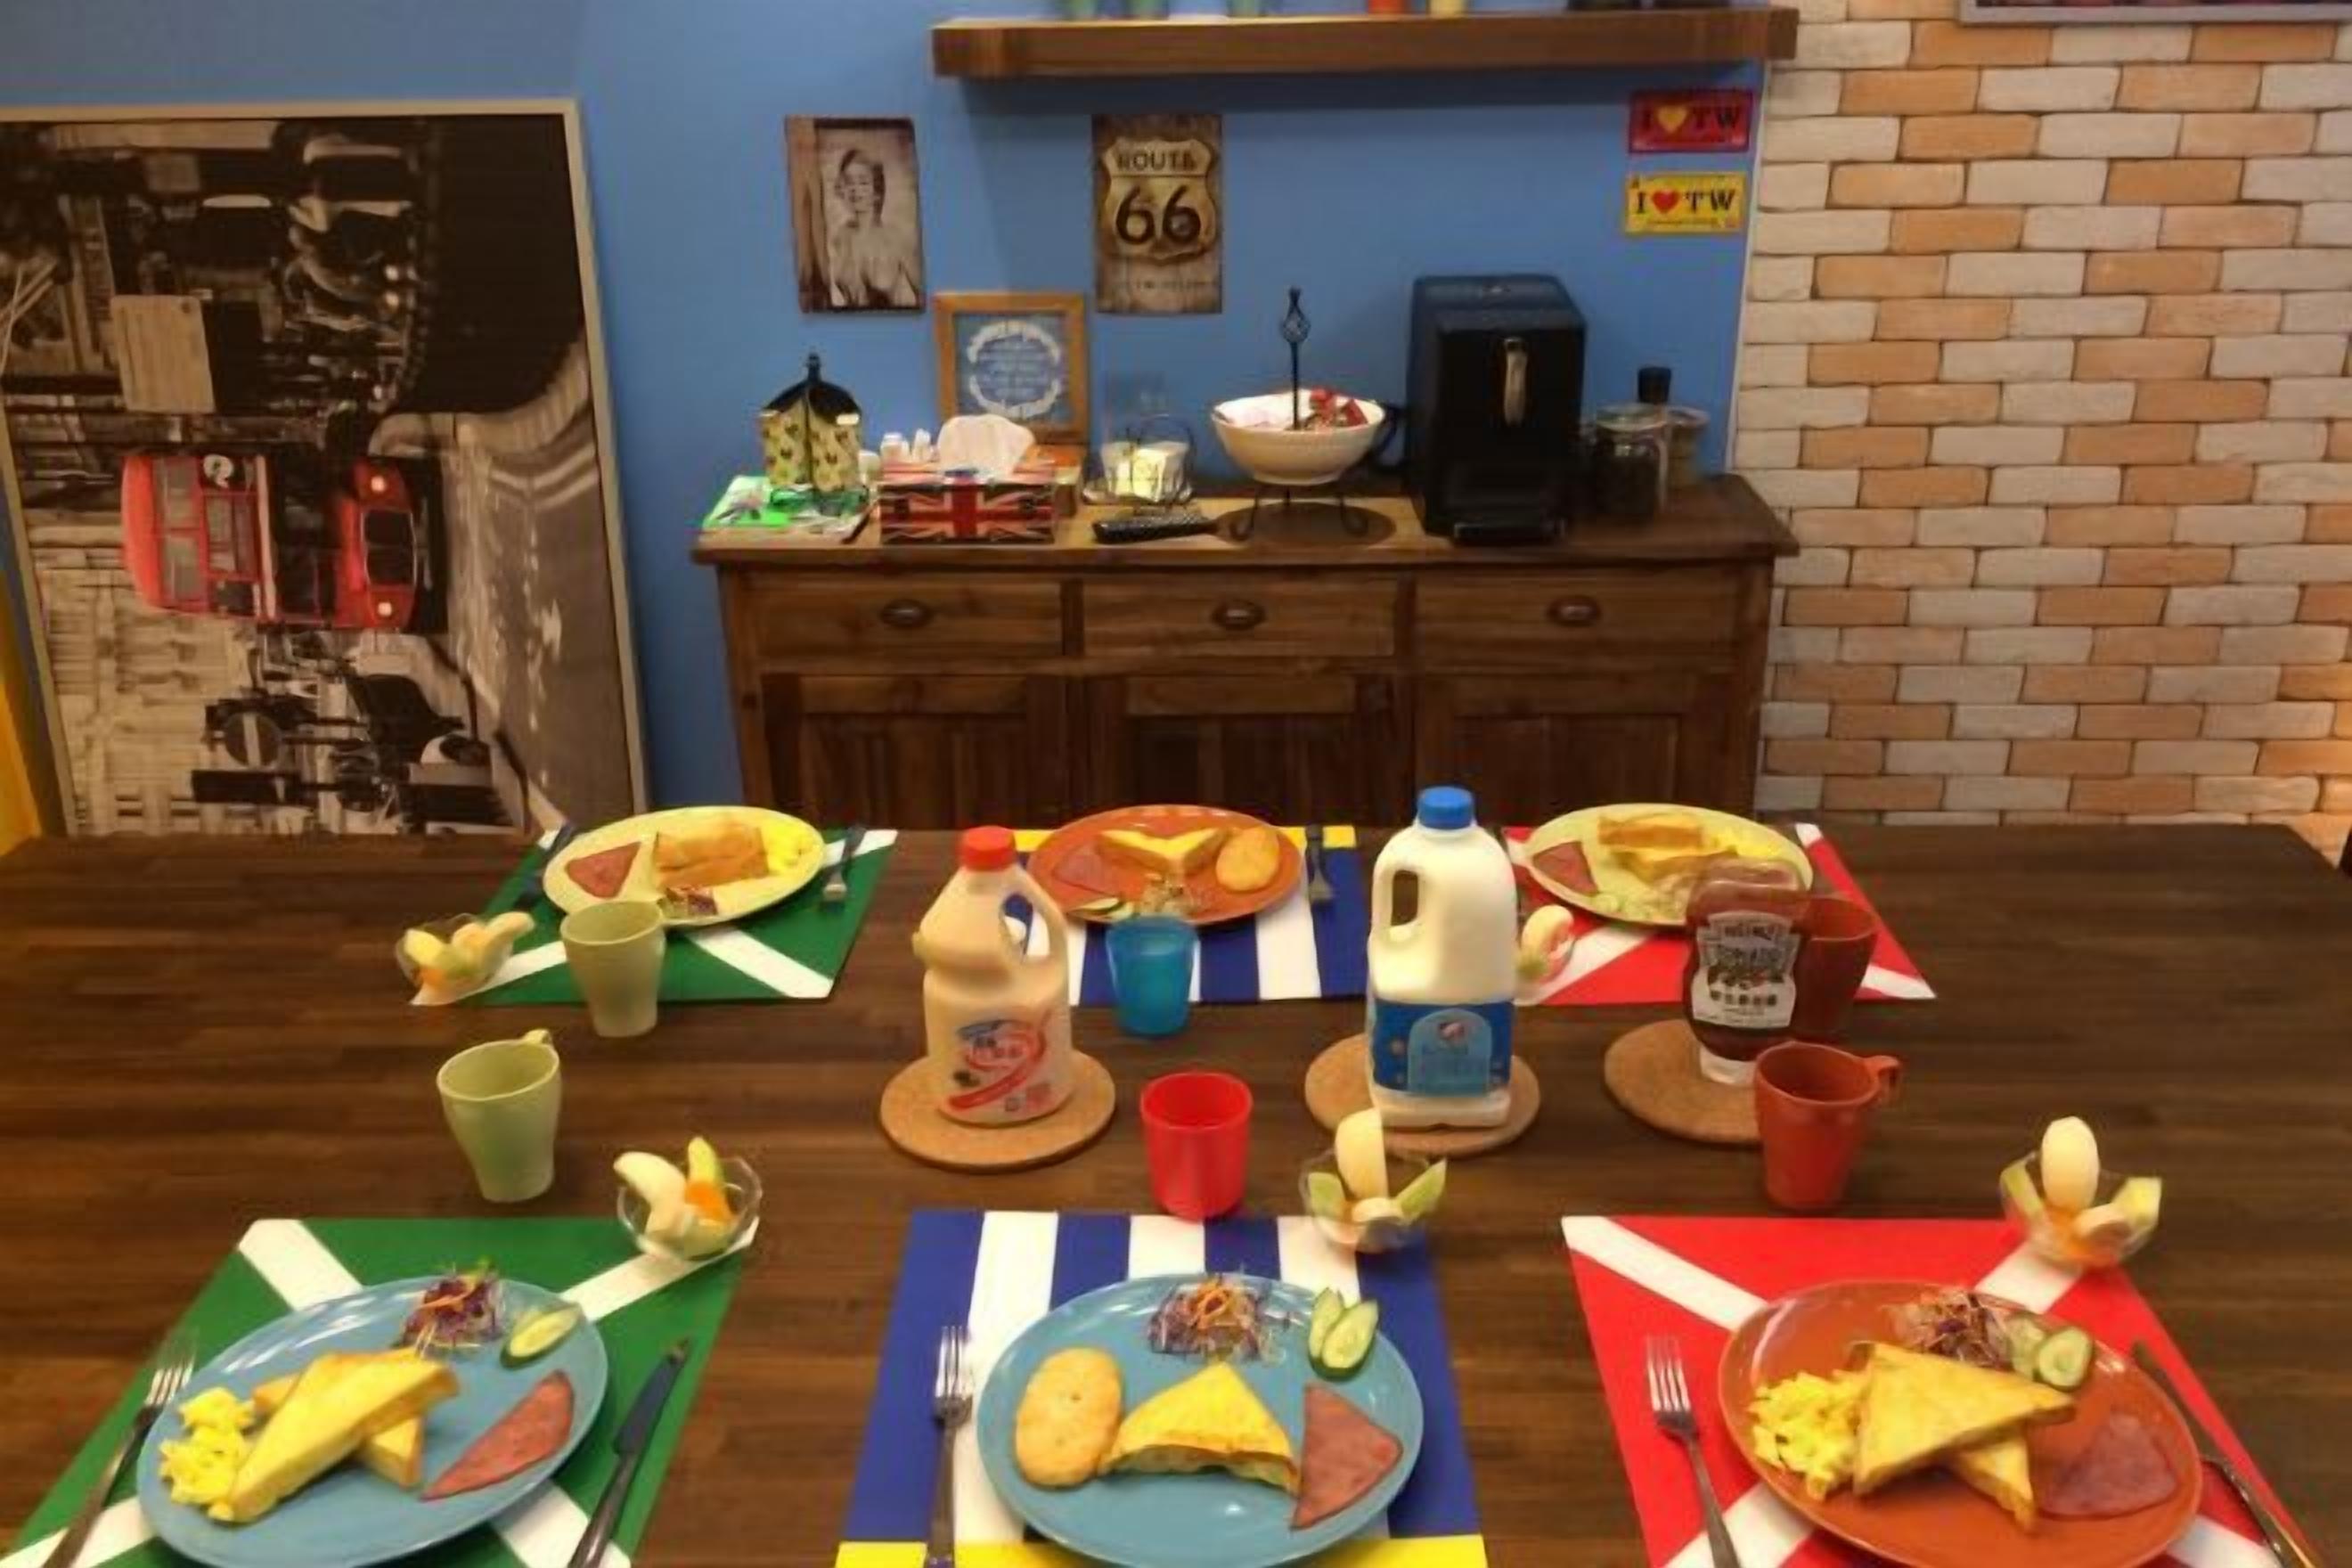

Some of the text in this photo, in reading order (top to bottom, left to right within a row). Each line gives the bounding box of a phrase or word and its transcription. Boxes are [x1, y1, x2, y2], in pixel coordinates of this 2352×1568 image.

[1117, 150, 1197, 171] ROUTE
[1637, 189, 1736, 214] I TW
[1115, 185, 1201, 244] 66
